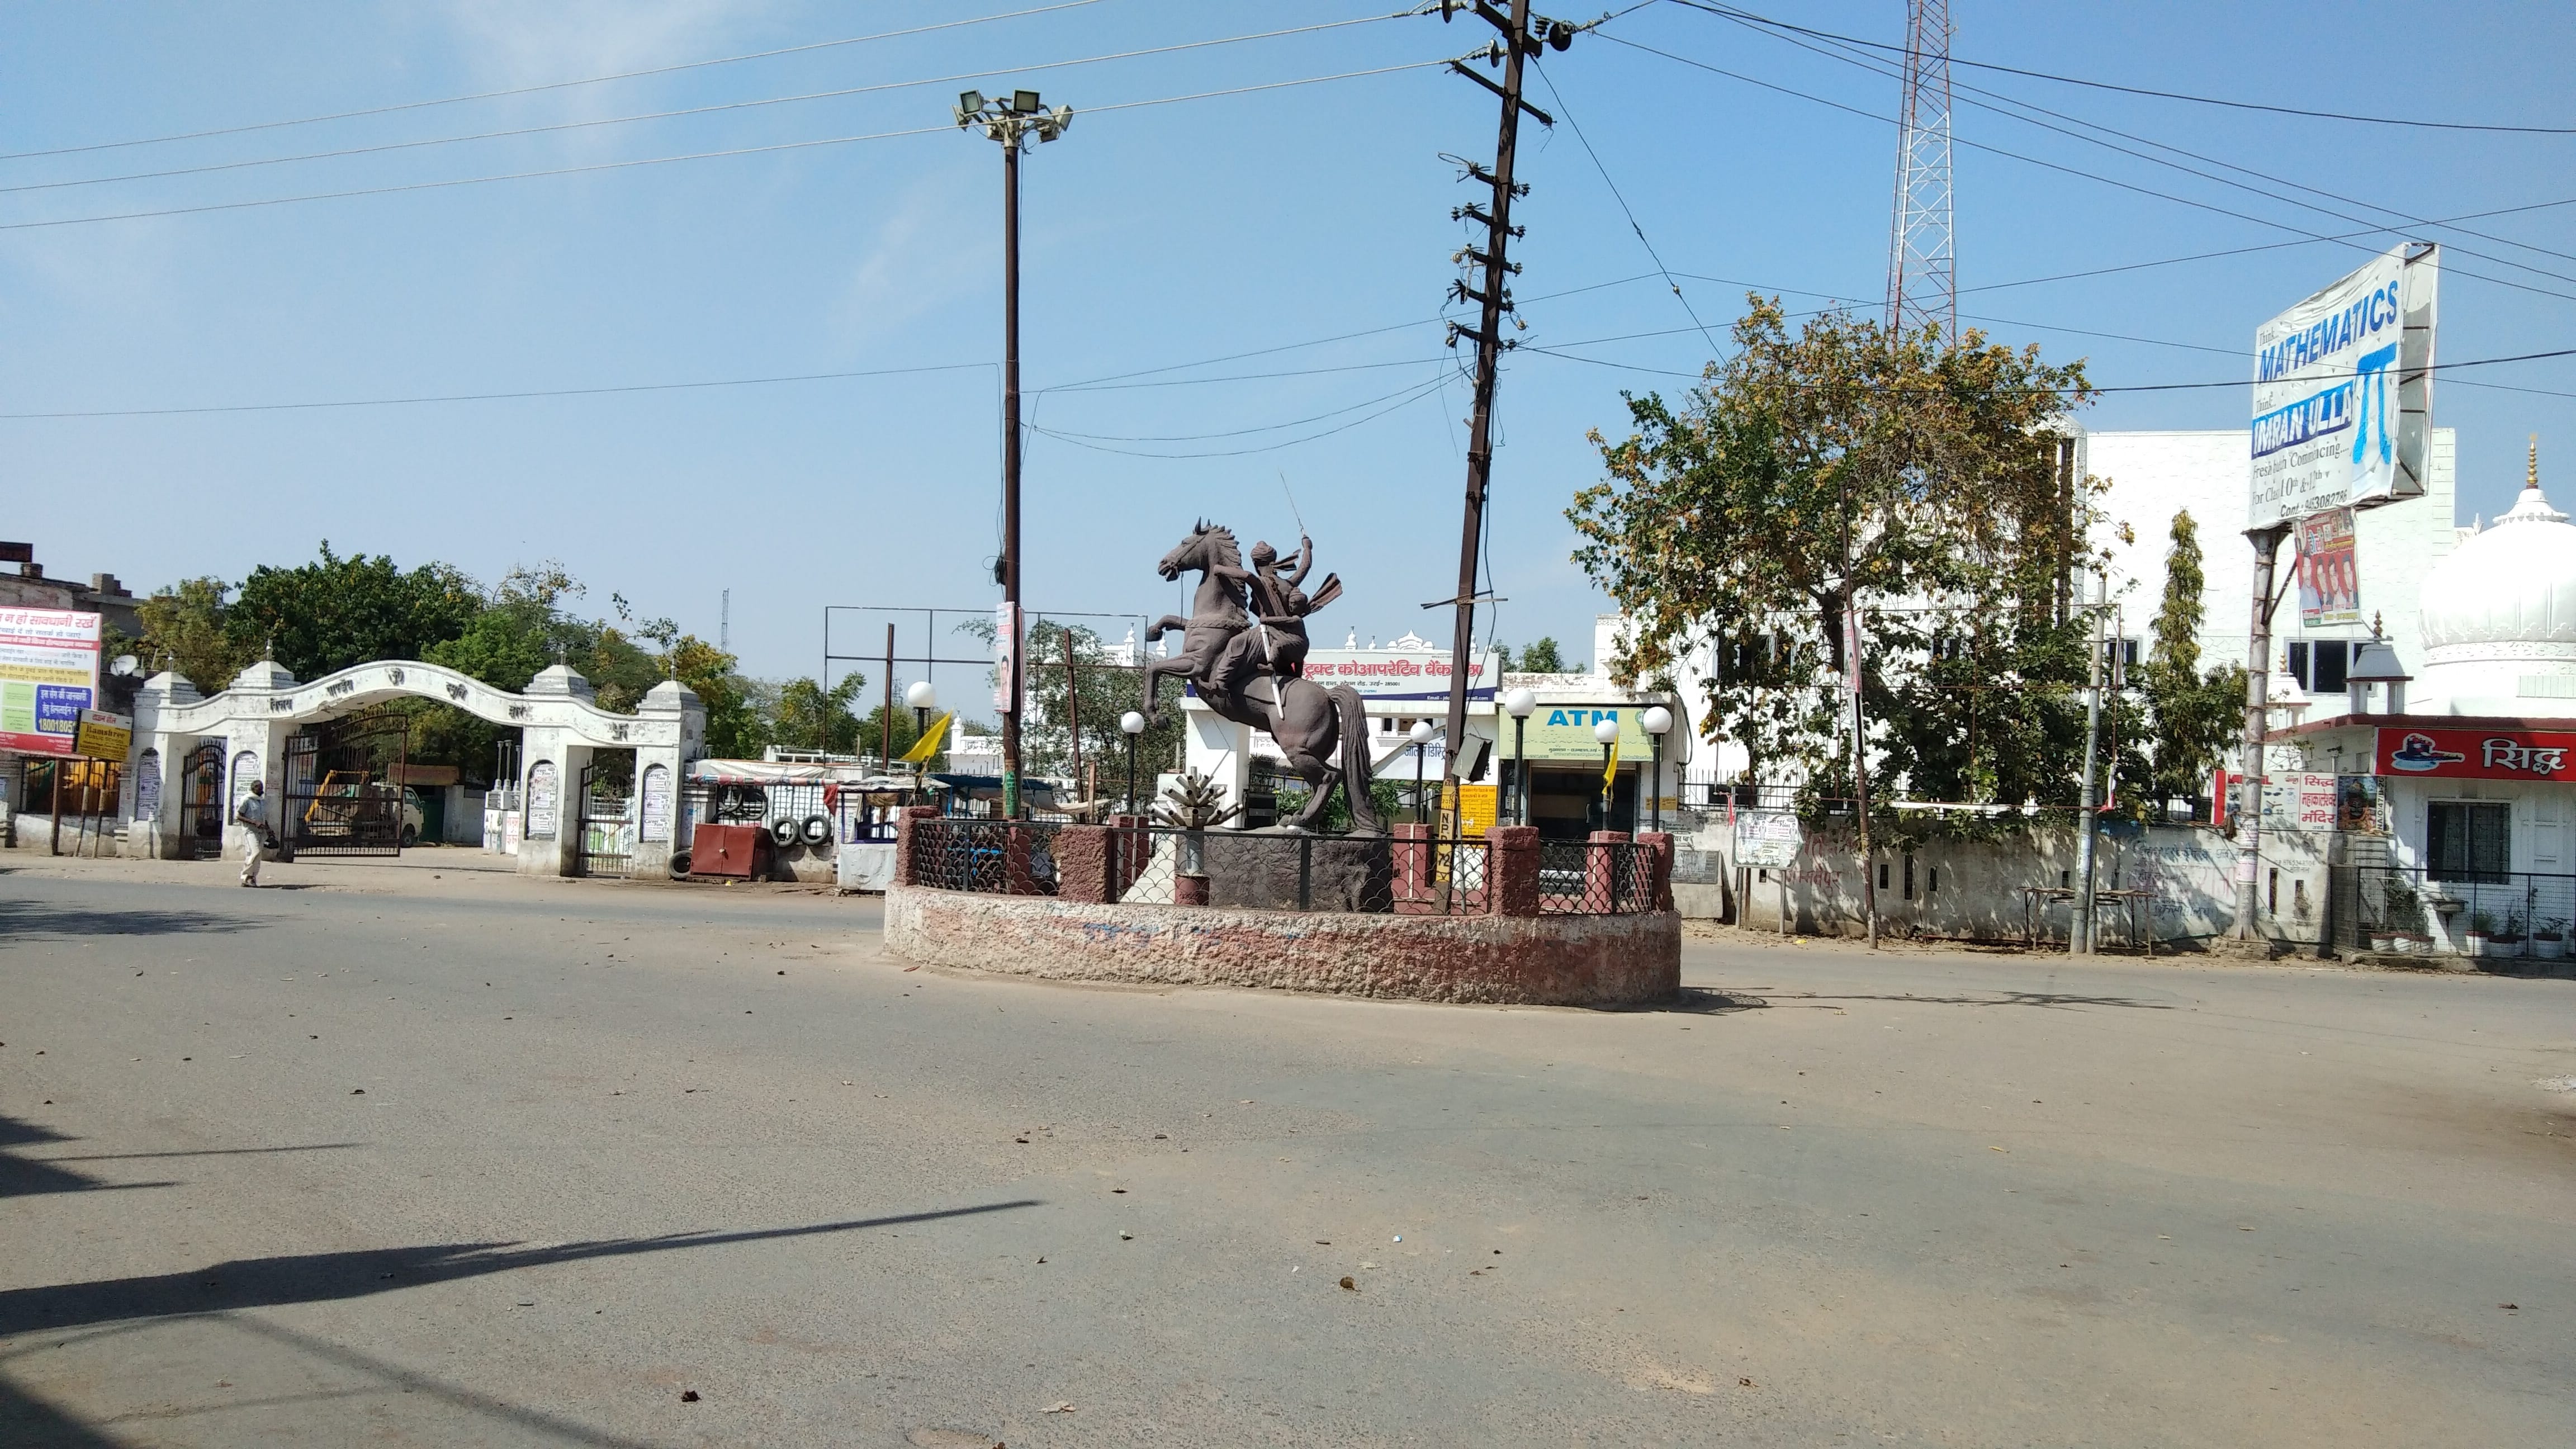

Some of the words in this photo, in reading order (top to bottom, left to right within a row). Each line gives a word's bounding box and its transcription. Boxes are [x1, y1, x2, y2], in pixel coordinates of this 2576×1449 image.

[2258, 280, 2398, 385] MATHEMATICS
[2253, 405, 2305, 454] IMRAN
[2308, 386, 2354, 435] ULLA
[2253, 461, 2272, 479] Fresh
[2252, 491, 2264, 505] For
[16, 612, 28, 624] हो
[30, 614, 73, 627] सावधानी
[75, 616, 97, 628] रखें
[1338, 659, 1423, 676] कोआपरेटिव
[1546, 710, 1618, 726] ATM
[2482, 732, 2569, 775] सिद्ध
[2304, 775, 2336, 787] सिद्ध
[2302, 810, 2336, 823] मंदिर
